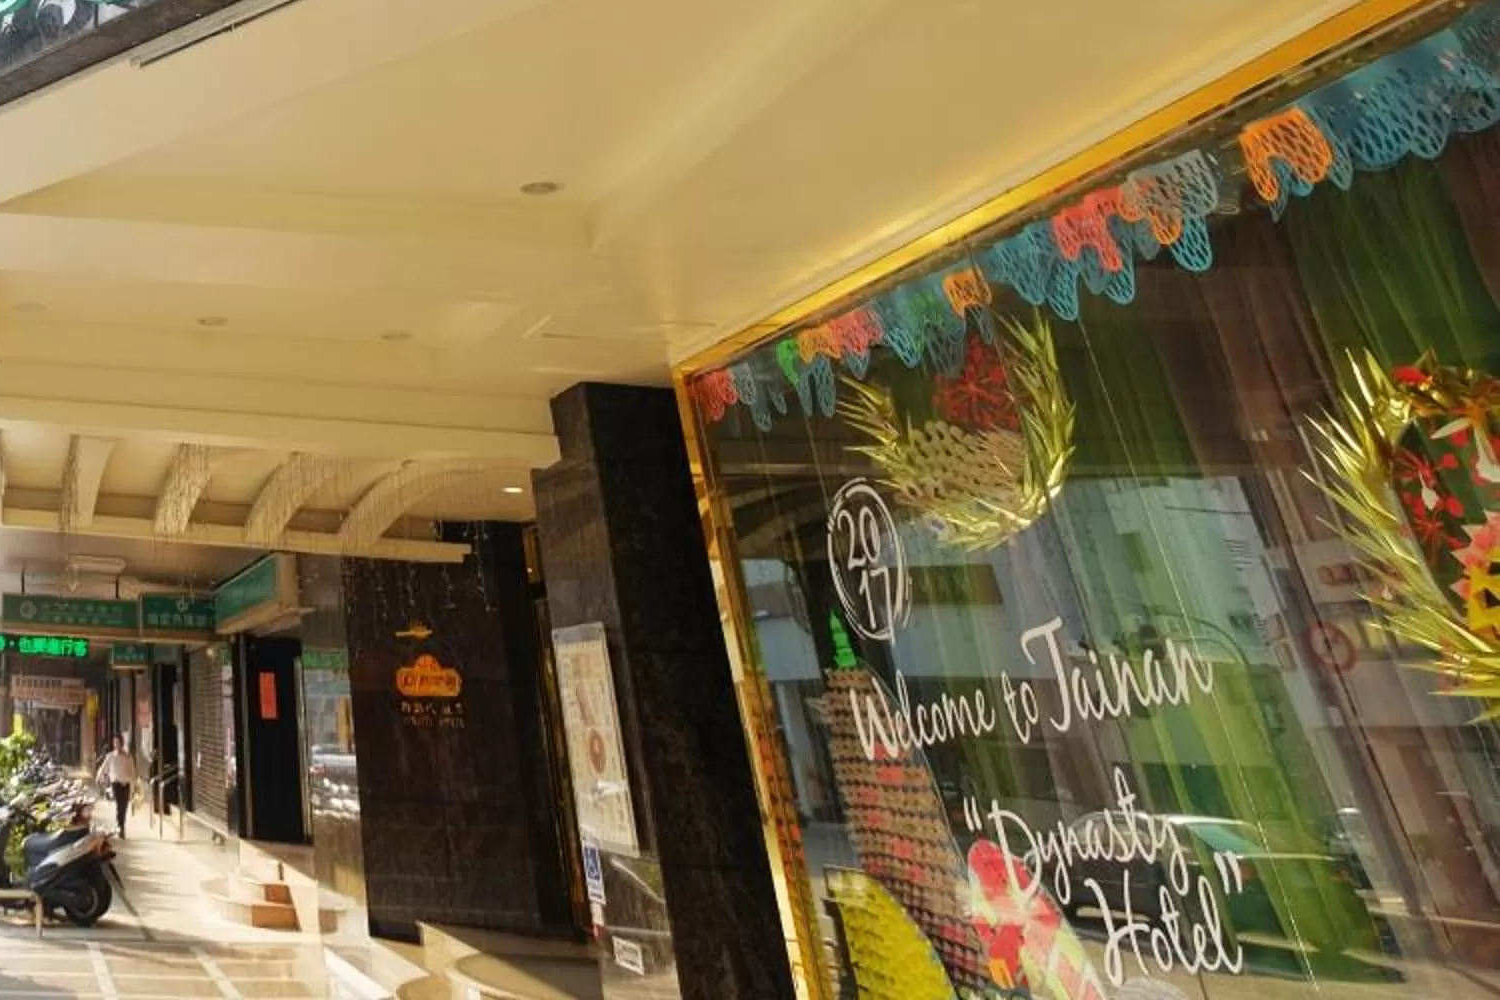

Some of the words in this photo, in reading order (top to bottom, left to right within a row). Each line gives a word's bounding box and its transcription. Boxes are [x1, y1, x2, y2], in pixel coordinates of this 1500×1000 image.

[836, 505, 881, 571] 20
[858, 565, 896, 647] 17
[850, 669, 995, 761] Welcome
[1001, 671, 1040, 744] to
[1020, 616, 1213, 733] Tainan
